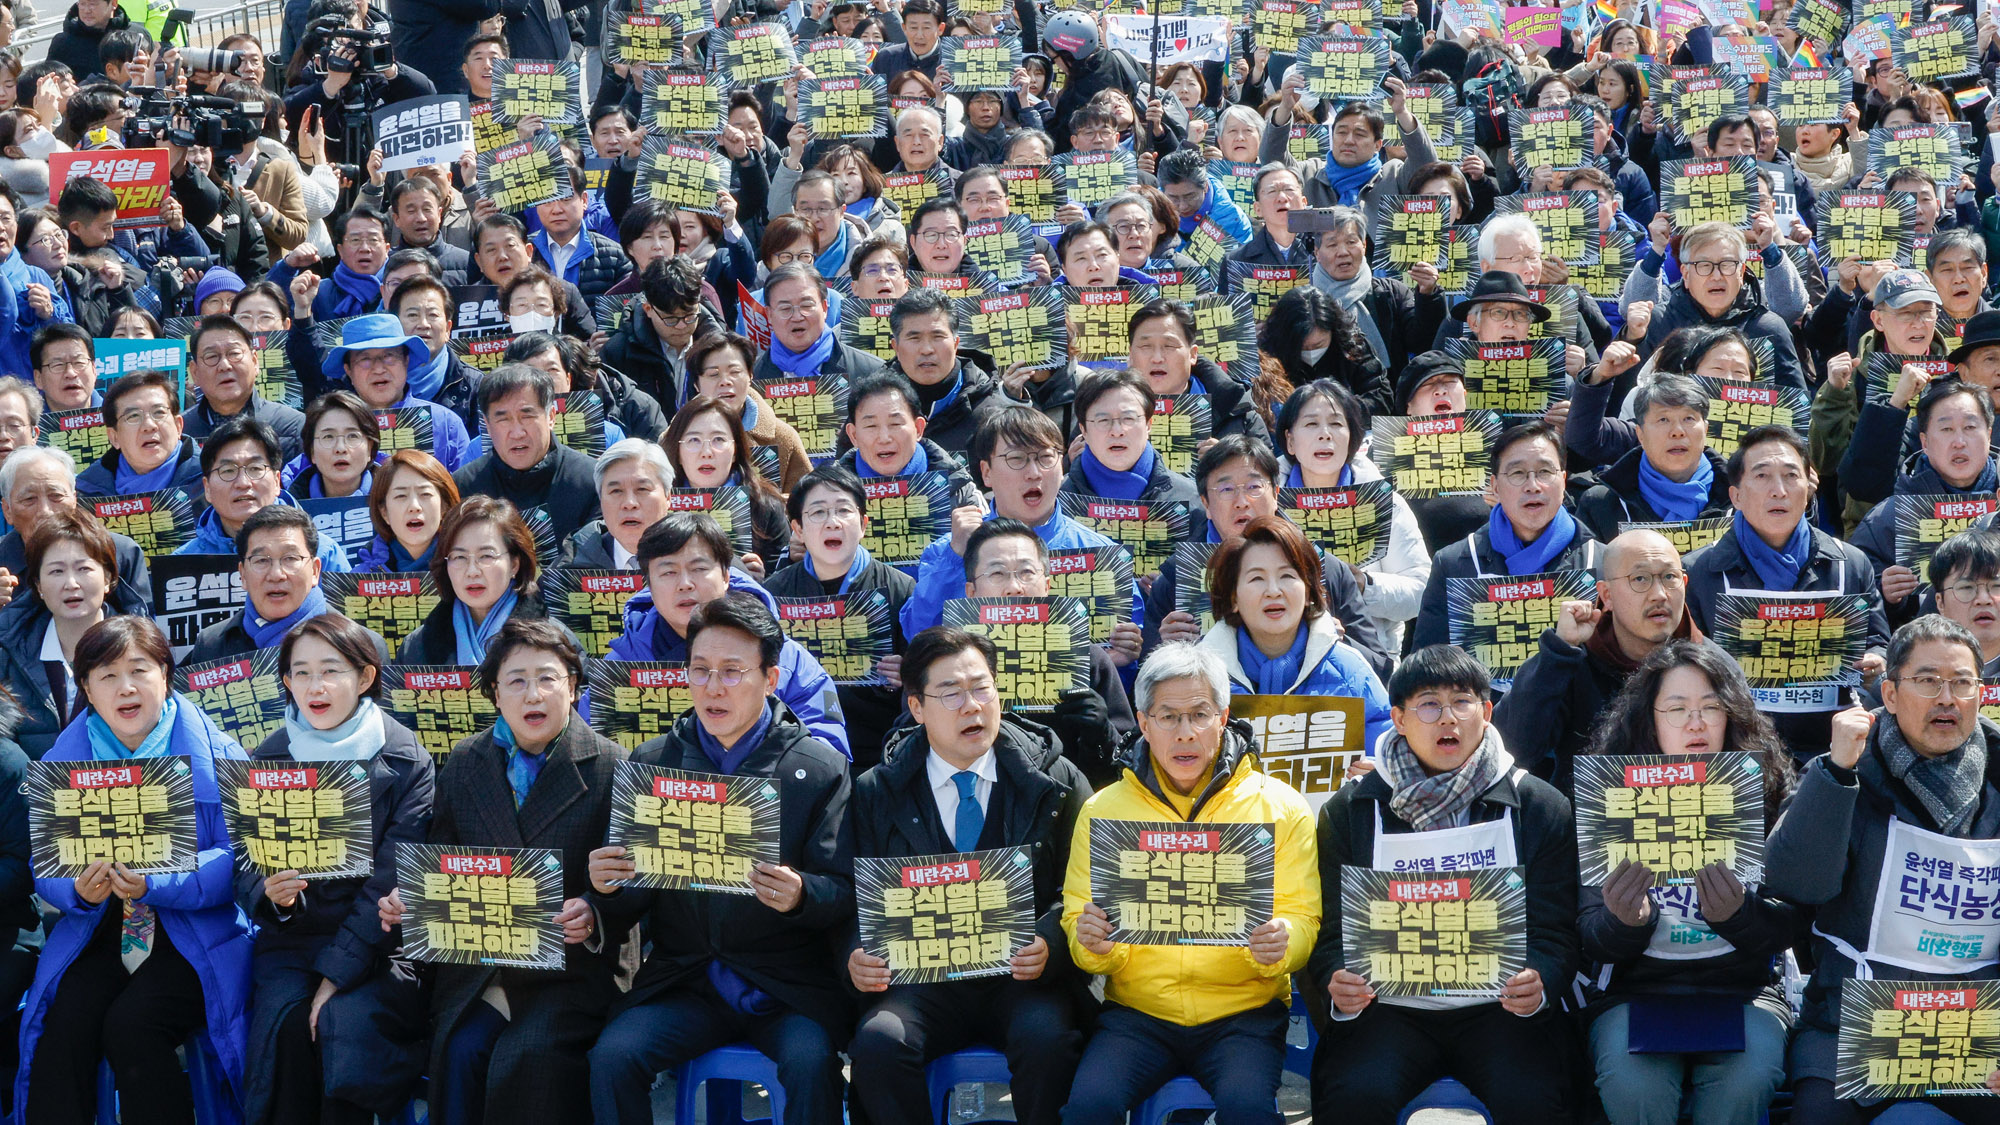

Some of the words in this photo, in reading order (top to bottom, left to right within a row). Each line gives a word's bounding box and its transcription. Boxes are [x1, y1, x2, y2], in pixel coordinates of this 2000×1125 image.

[1507, 16, 1532, 34] 평등의
[1730, 55, 1760, 63] 윤석열도
[1750, 45, 1773, 53] 차별도
[1743, 64, 1765, 74] 사회로
[379, 101, 461, 138] 윤석열을
[380, 123, 470, 159] 파면하라!
[65, 159, 156, 184] 윤석열을
[123, 347, 180, 372] 윤석열을
[1483, 346, 1524, 358] 내란수괴
[1464, 358, 1548, 379] 윤석열을
[1412, 419, 1455, 433] 내란수괴
[1394, 430, 1484, 457] 윤석열을
[1395, 466, 1487, 492] 파면하라
[101, 499, 145, 515] 내란수괴
[1094, 504, 1139, 519] 내란수괴
[1939, 503, 1986, 516] 내란수괴
[313, 507, 373, 541] 열을
[587, 576, 636, 591] 내란수괴
[1494, 581, 1544, 599] 내란수괴
[987, 605, 1038, 621] 내란수괴
[1764, 604, 1815, 618] 내란수괴
[1739, 618, 1844, 643] 윤석열을
[194, 665, 244, 687] 내란수괴
[410, 672, 461, 687] 내란수괴
[1785, 689, 1823, 704] 박수현
[76, 768, 131, 786] 내란수괴
[255, 771, 307, 787] 내란수괴
[1631, 764, 1694, 784] 내란수괴
[659, 779, 716, 799] 내란수괴
[53, 784, 167, 819] 윤석열을
[237, 788, 343, 816] 윤석열을
[1605, 782, 1733, 821] 윤석열을
[634, 796, 751, 835] 윤석열을
[55, 833, 170, 867] 파면하라
[1146, 831, 1208, 849] 내란수괴
[246, 837, 348, 869] 파면하라
[446, 854, 501, 872] 내란수괴
[1441, 847, 1496, 871] 즉각파면
[633, 846, 750, 884] 파면하라
[908, 862, 969, 884] 내란수괴
[1120, 852, 1246, 883] 윤석열을
[1905, 852, 1953, 880] 윤석열
[425, 874, 537, 906] 윤석열을
[883, 878, 1008, 921] 윤석열을
[1396, 880, 1458, 899] 내란수괴
[1118, 903, 1245, 935] 파면하라
[1370, 900, 1498, 933] 윤석열을
[427, 922, 539, 955] 파면하라
[1917, 936, 1982, 958] 비상행동
[886, 931, 1010, 973] 파면하라
[1369, 953, 1498, 985] 파면하라
[1901, 990, 1965, 1007] 내란수괴
[1871, 1009, 2000, 1039] 윤석열을
